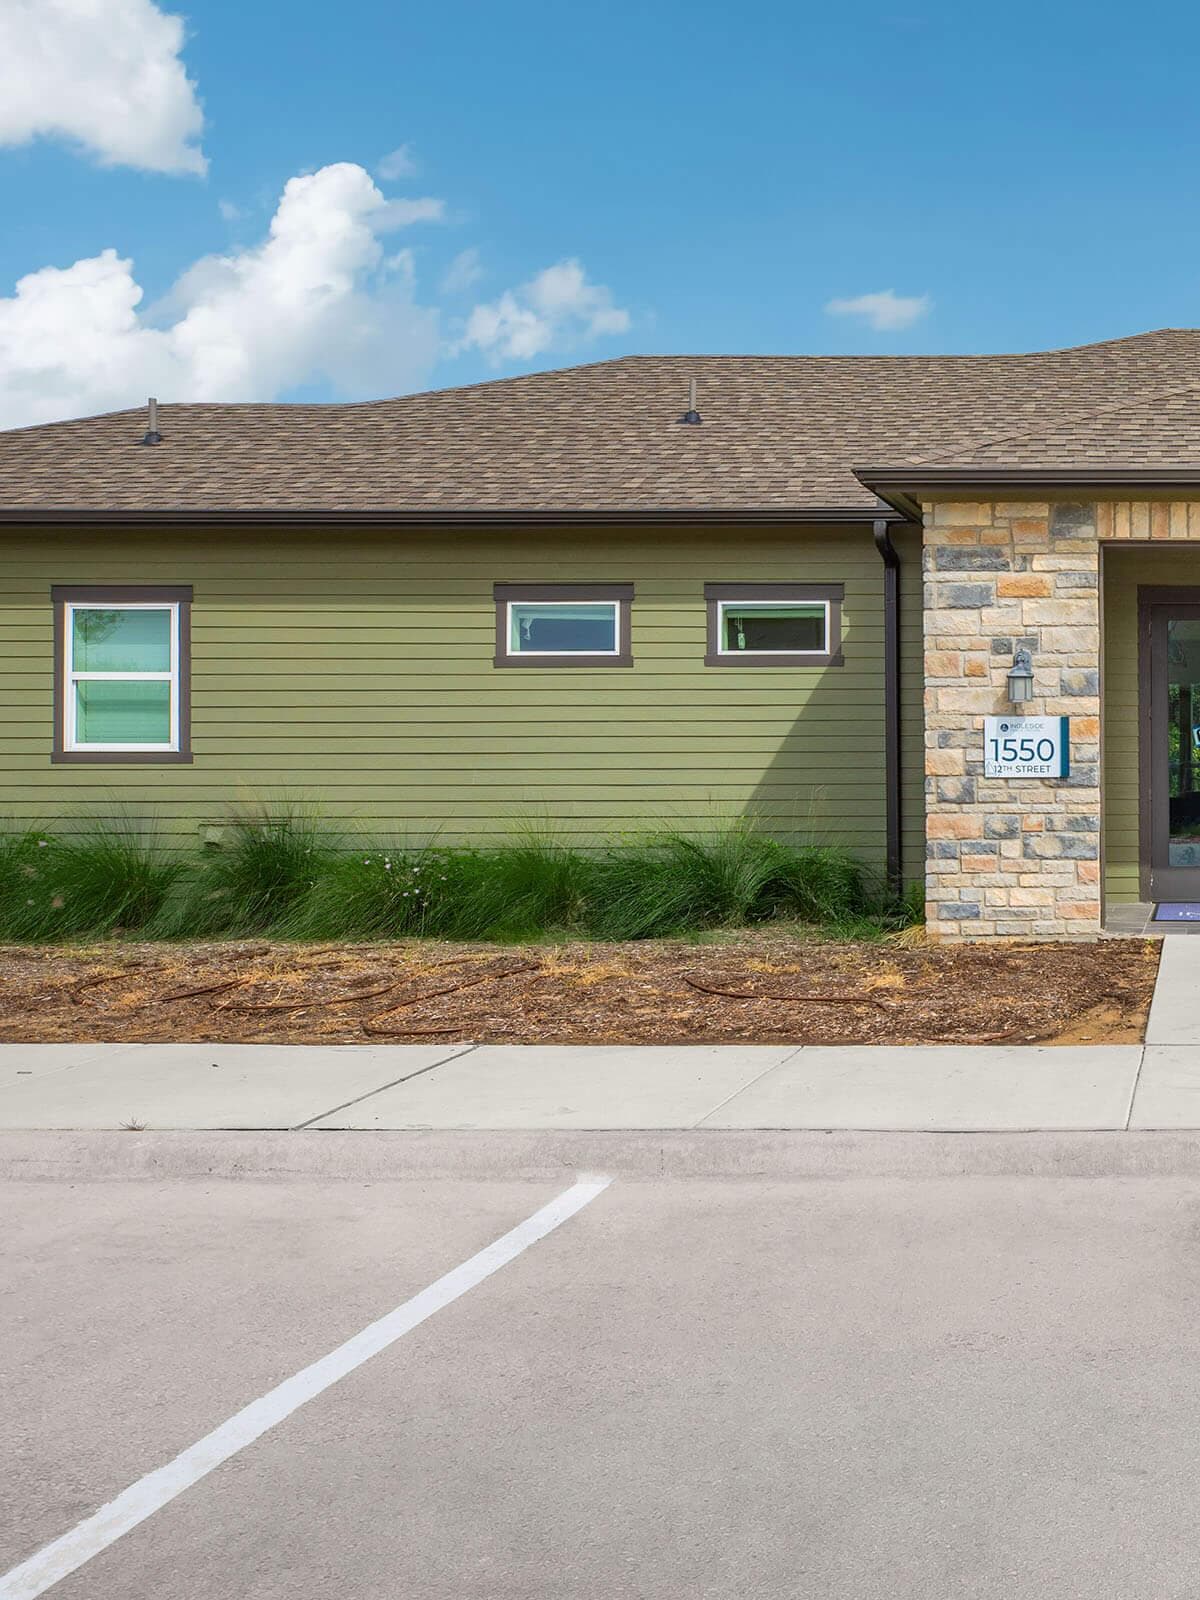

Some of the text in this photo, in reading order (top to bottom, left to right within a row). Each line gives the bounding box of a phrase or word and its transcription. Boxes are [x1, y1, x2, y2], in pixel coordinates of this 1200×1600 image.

[989, 738, 1055, 762] 1550
[993, 764, 1051, 774] 12TH STREET
